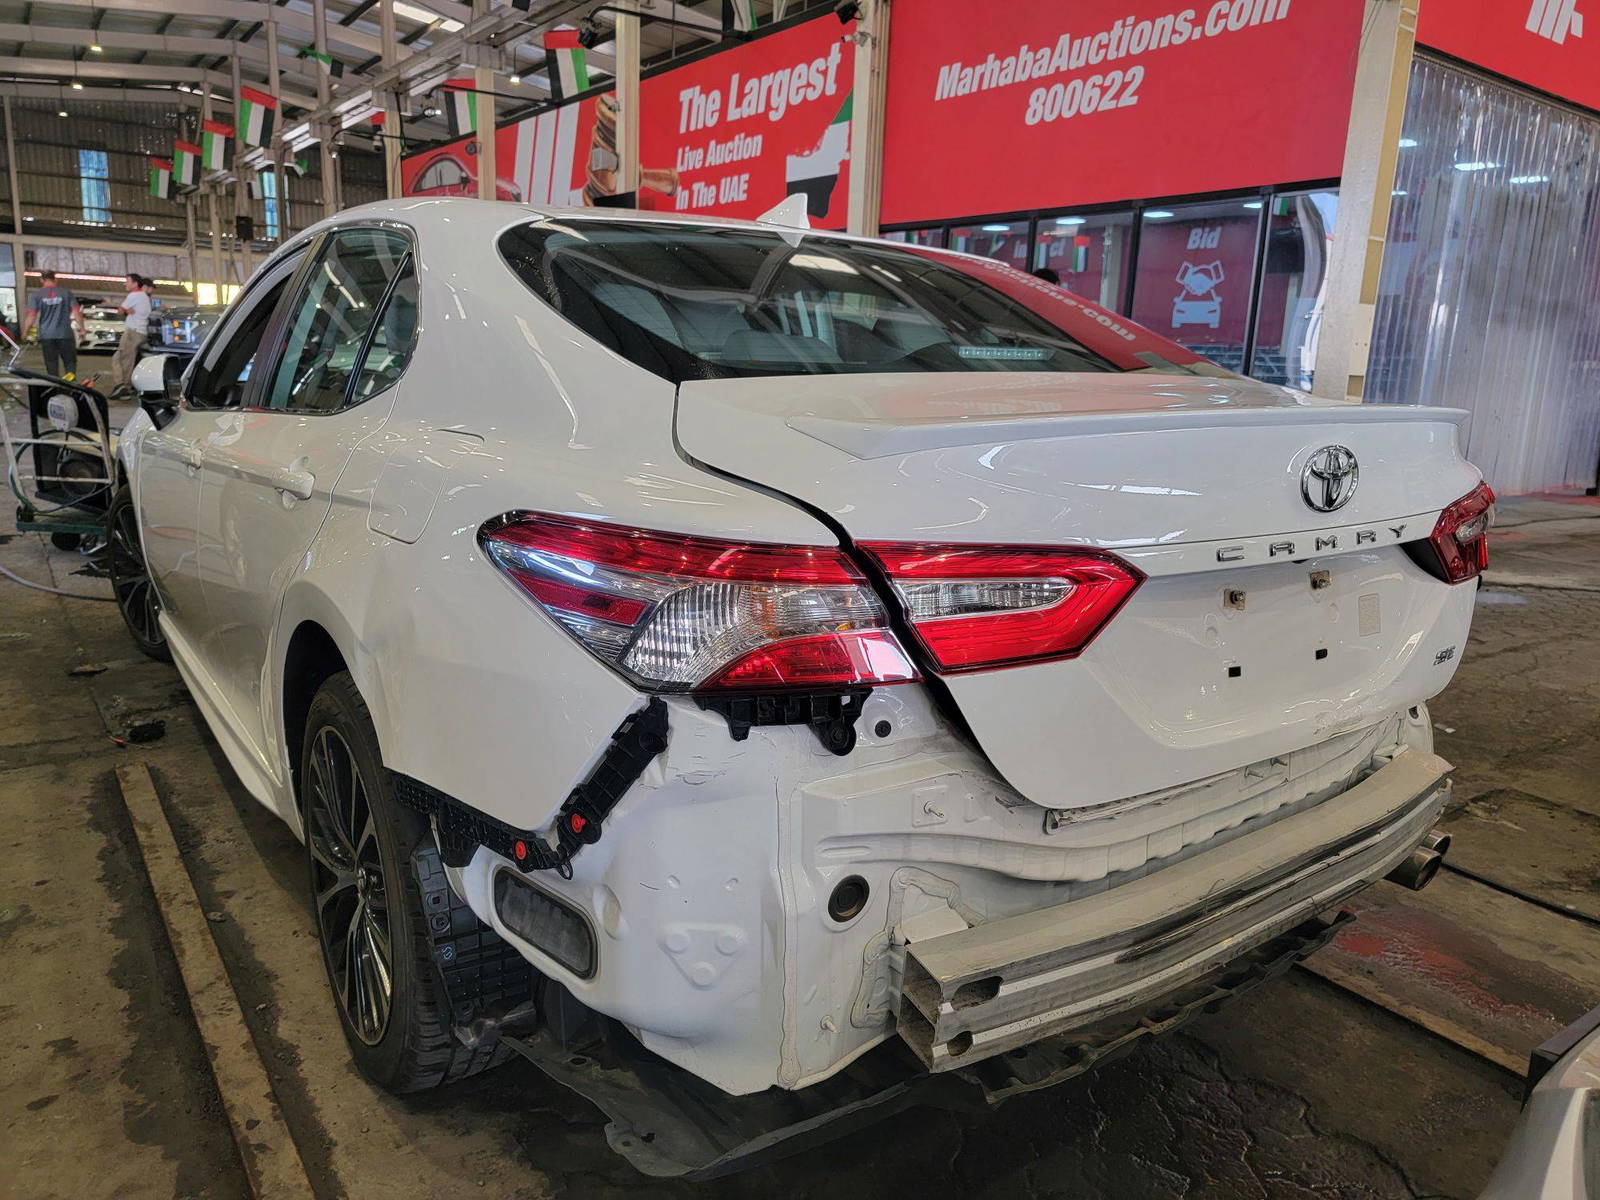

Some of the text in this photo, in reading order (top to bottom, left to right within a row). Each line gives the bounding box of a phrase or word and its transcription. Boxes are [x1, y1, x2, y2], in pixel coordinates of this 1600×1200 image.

[934, 0, 1294, 101] MarhabaAuctions.com
[679, 41, 843, 134] The Largest
[1024, 65, 1146, 126] 800622
[676, 132, 763, 173] Live Auction
[675, 172, 750, 211] In The UAE
[1186, 226, 1222, 250] Bid
[1216, 523, 1408, 563] CAMRY
